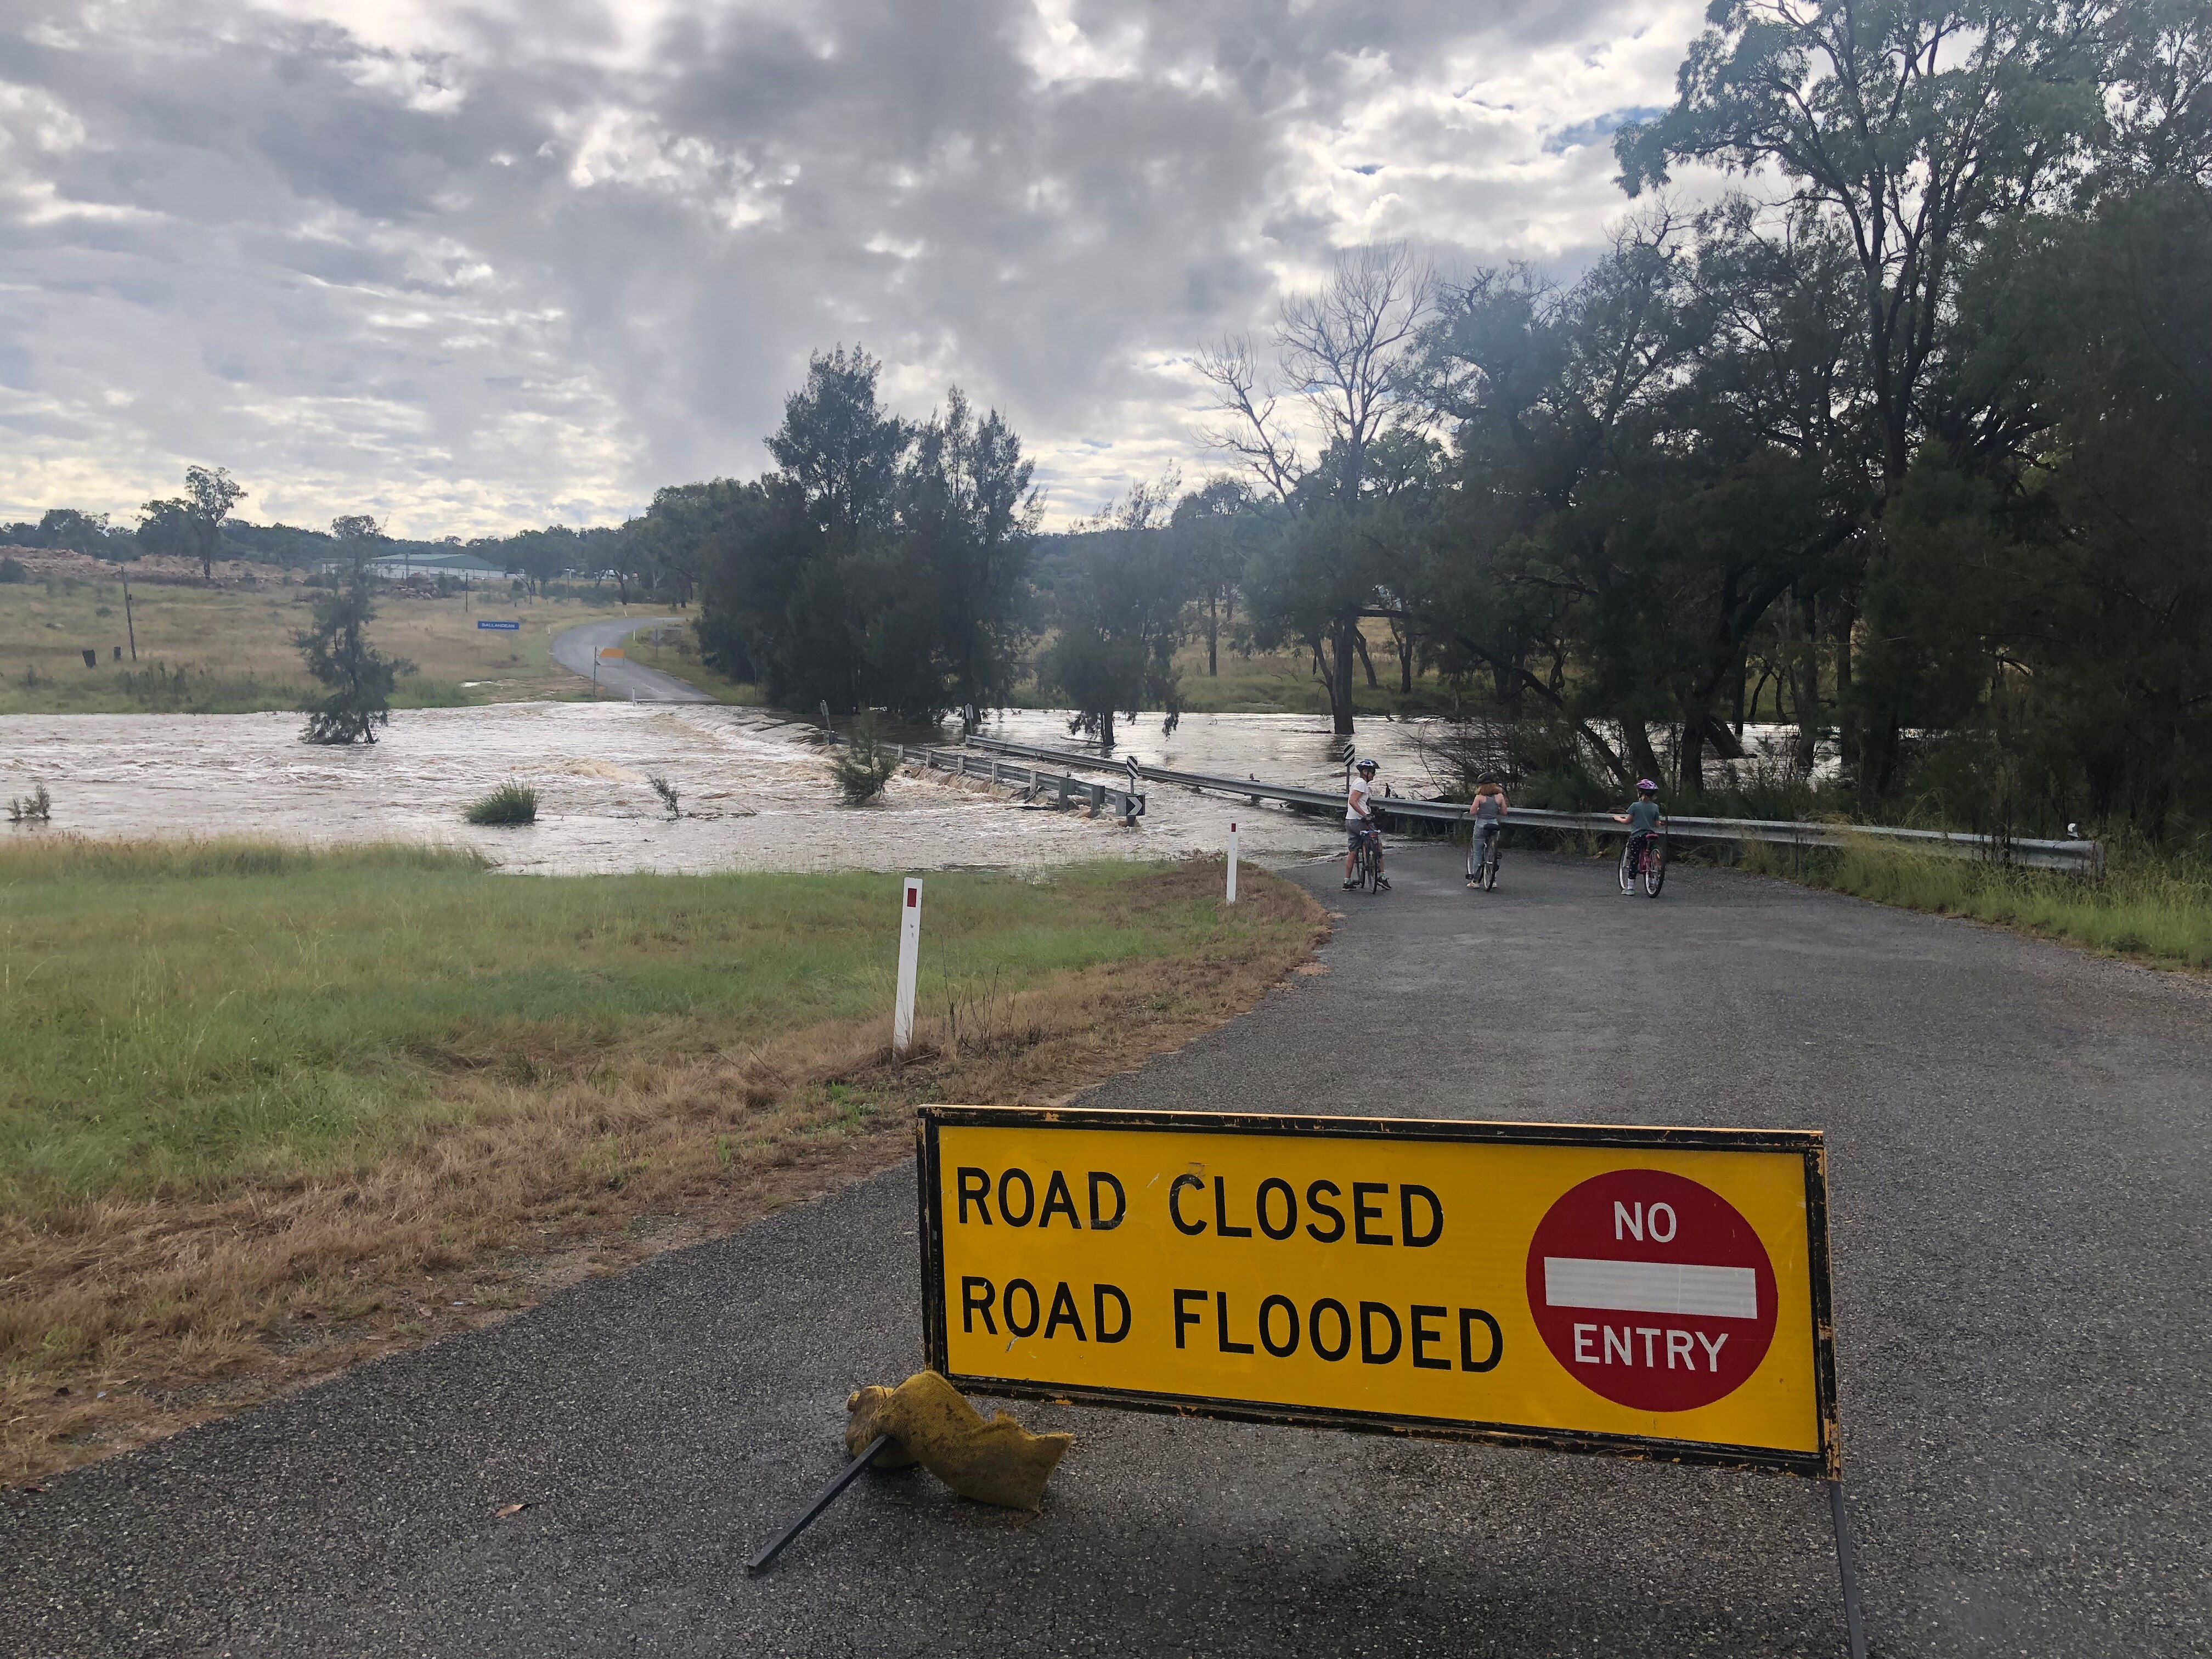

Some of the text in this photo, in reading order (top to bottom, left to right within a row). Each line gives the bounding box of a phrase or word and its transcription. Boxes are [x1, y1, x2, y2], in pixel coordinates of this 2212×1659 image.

[957, 1166, 1444, 1248] ROAD CLOSED
[1614, 1201, 1677, 1243] NO
[961, 1276, 1503, 1373] ROAD FLOODED
[1573, 1323, 1729, 1372] ENTRY
